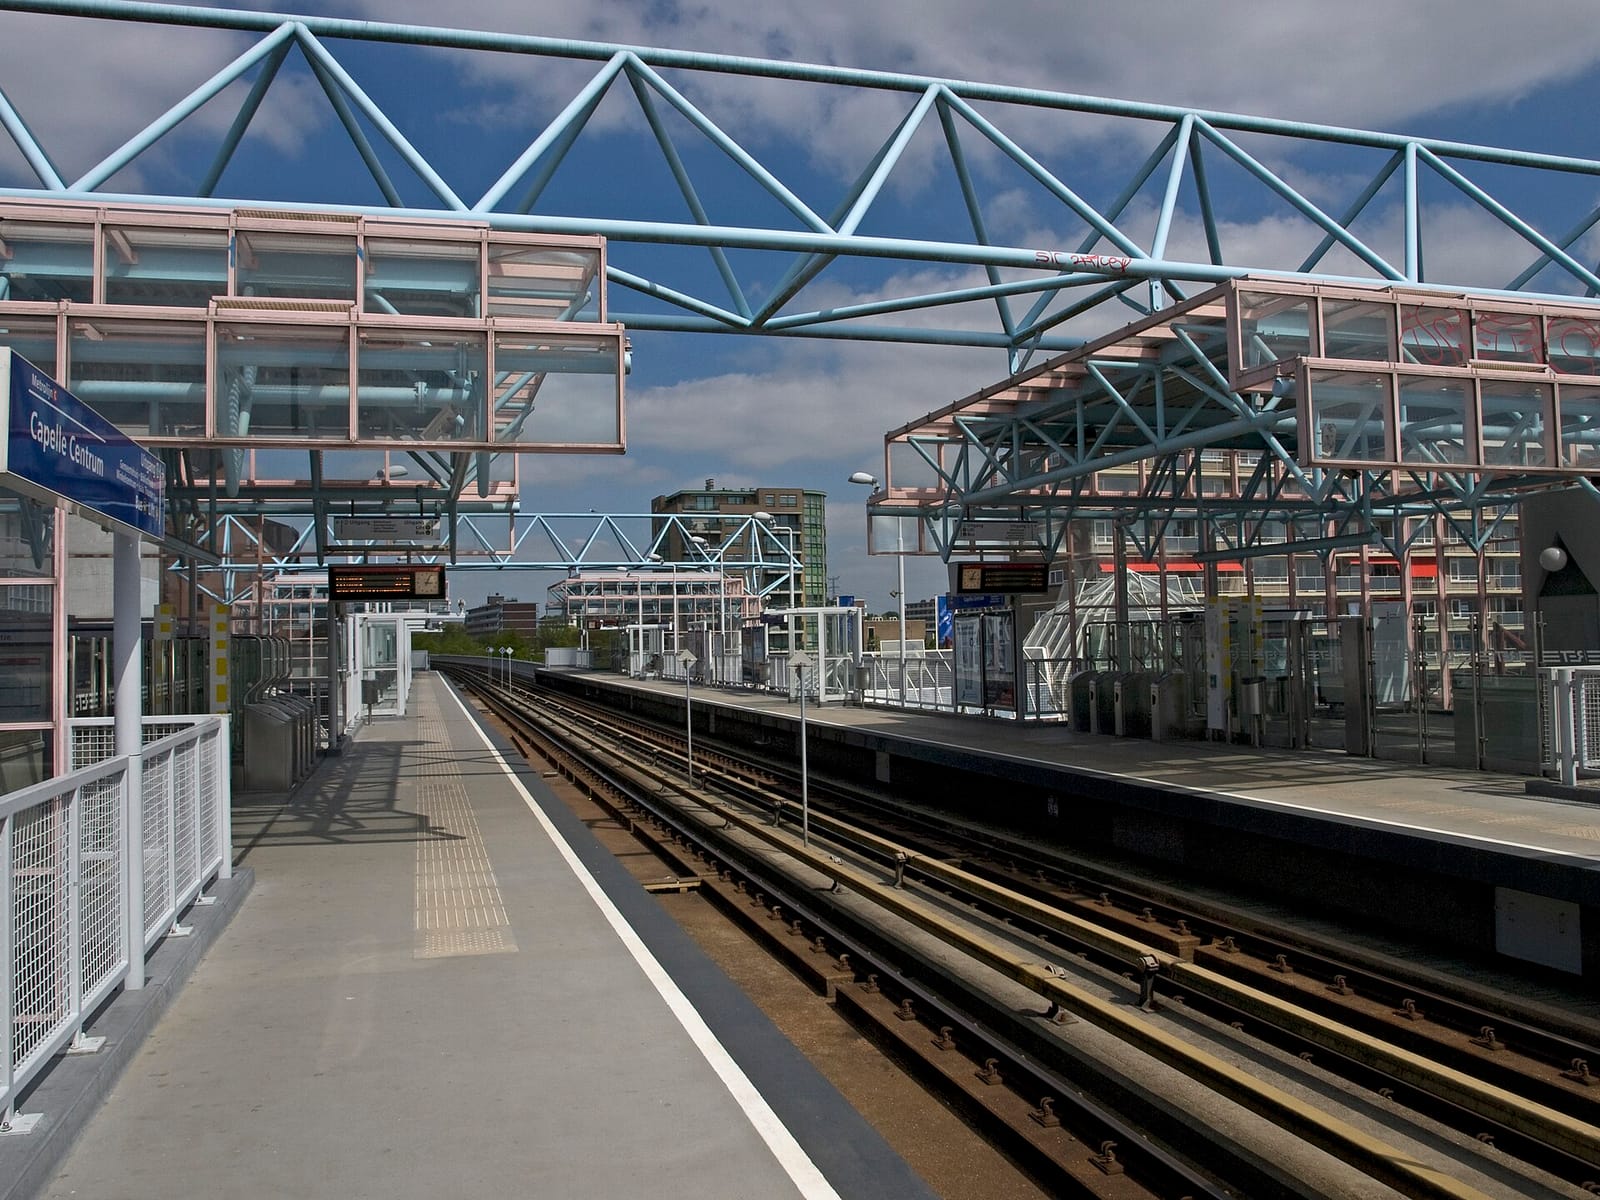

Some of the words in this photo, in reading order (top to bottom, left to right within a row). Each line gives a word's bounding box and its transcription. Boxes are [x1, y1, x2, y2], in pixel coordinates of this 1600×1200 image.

[31, 373, 54, 400] Metrolijn
[30, 411, 67, 457] Capelle
[69, 435, 104, 478] Centrum
